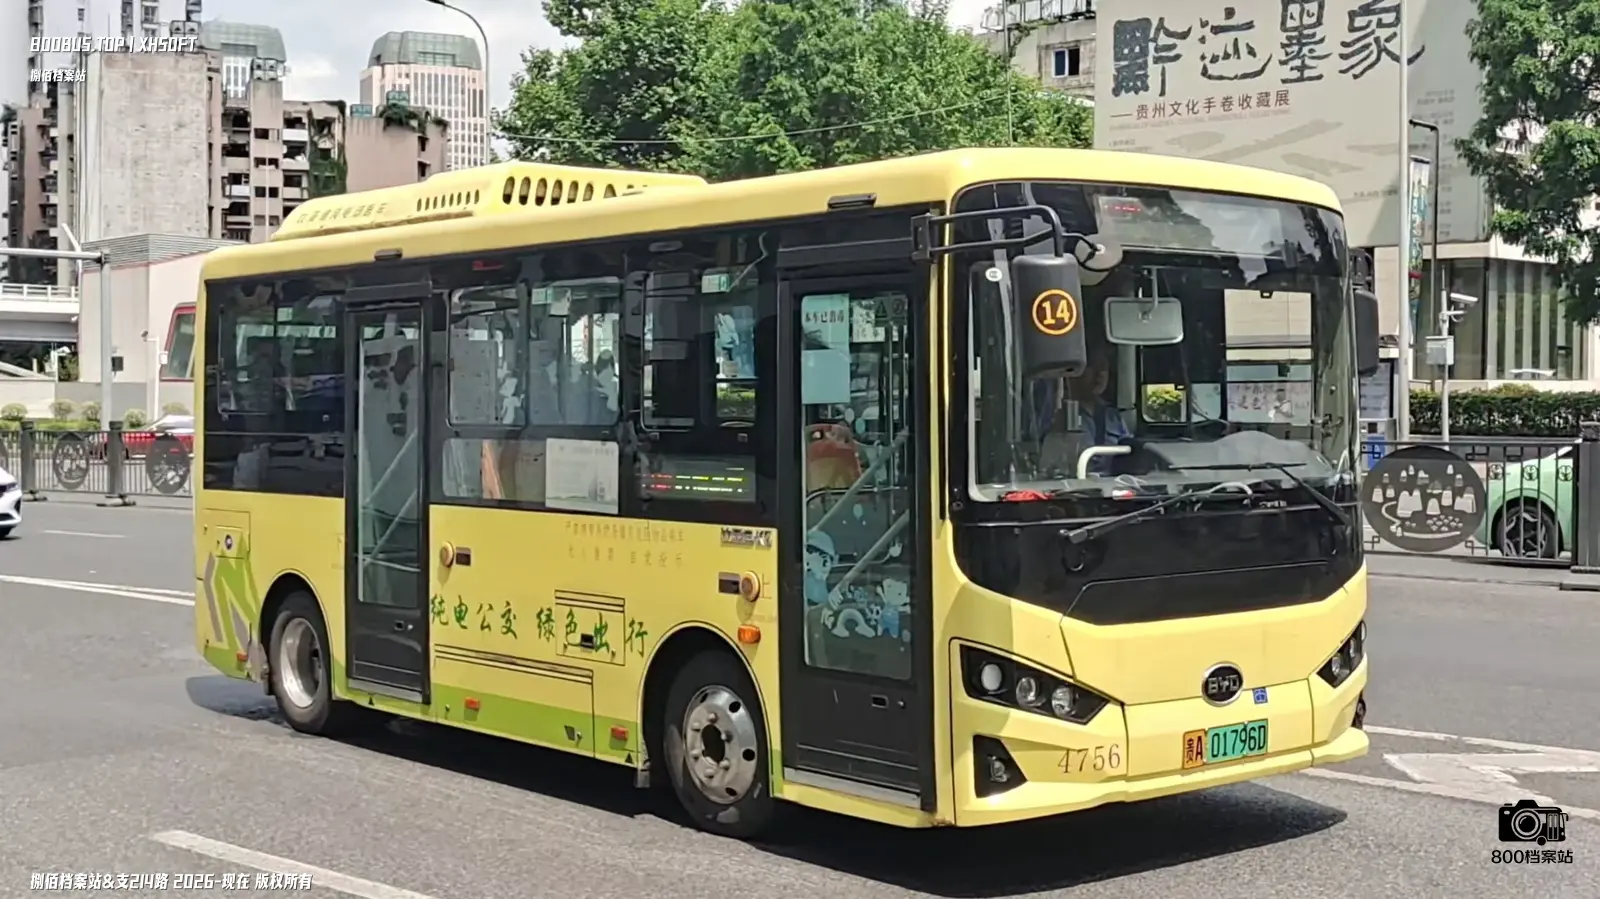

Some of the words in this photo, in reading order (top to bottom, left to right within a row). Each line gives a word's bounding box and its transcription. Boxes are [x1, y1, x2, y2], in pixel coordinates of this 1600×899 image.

[1040, 300, 1071, 325] 14
[431, 593, 517, 639] 纯电公交
[536, 607, 649, 658] 绿色出行
[1207, 674, 1240, 695] BYD
[1058, 743, 1121, 774] 4756
[1185, 735, 1203, 764] 贵A
[1211, 723, 1267, 759] 01796D
